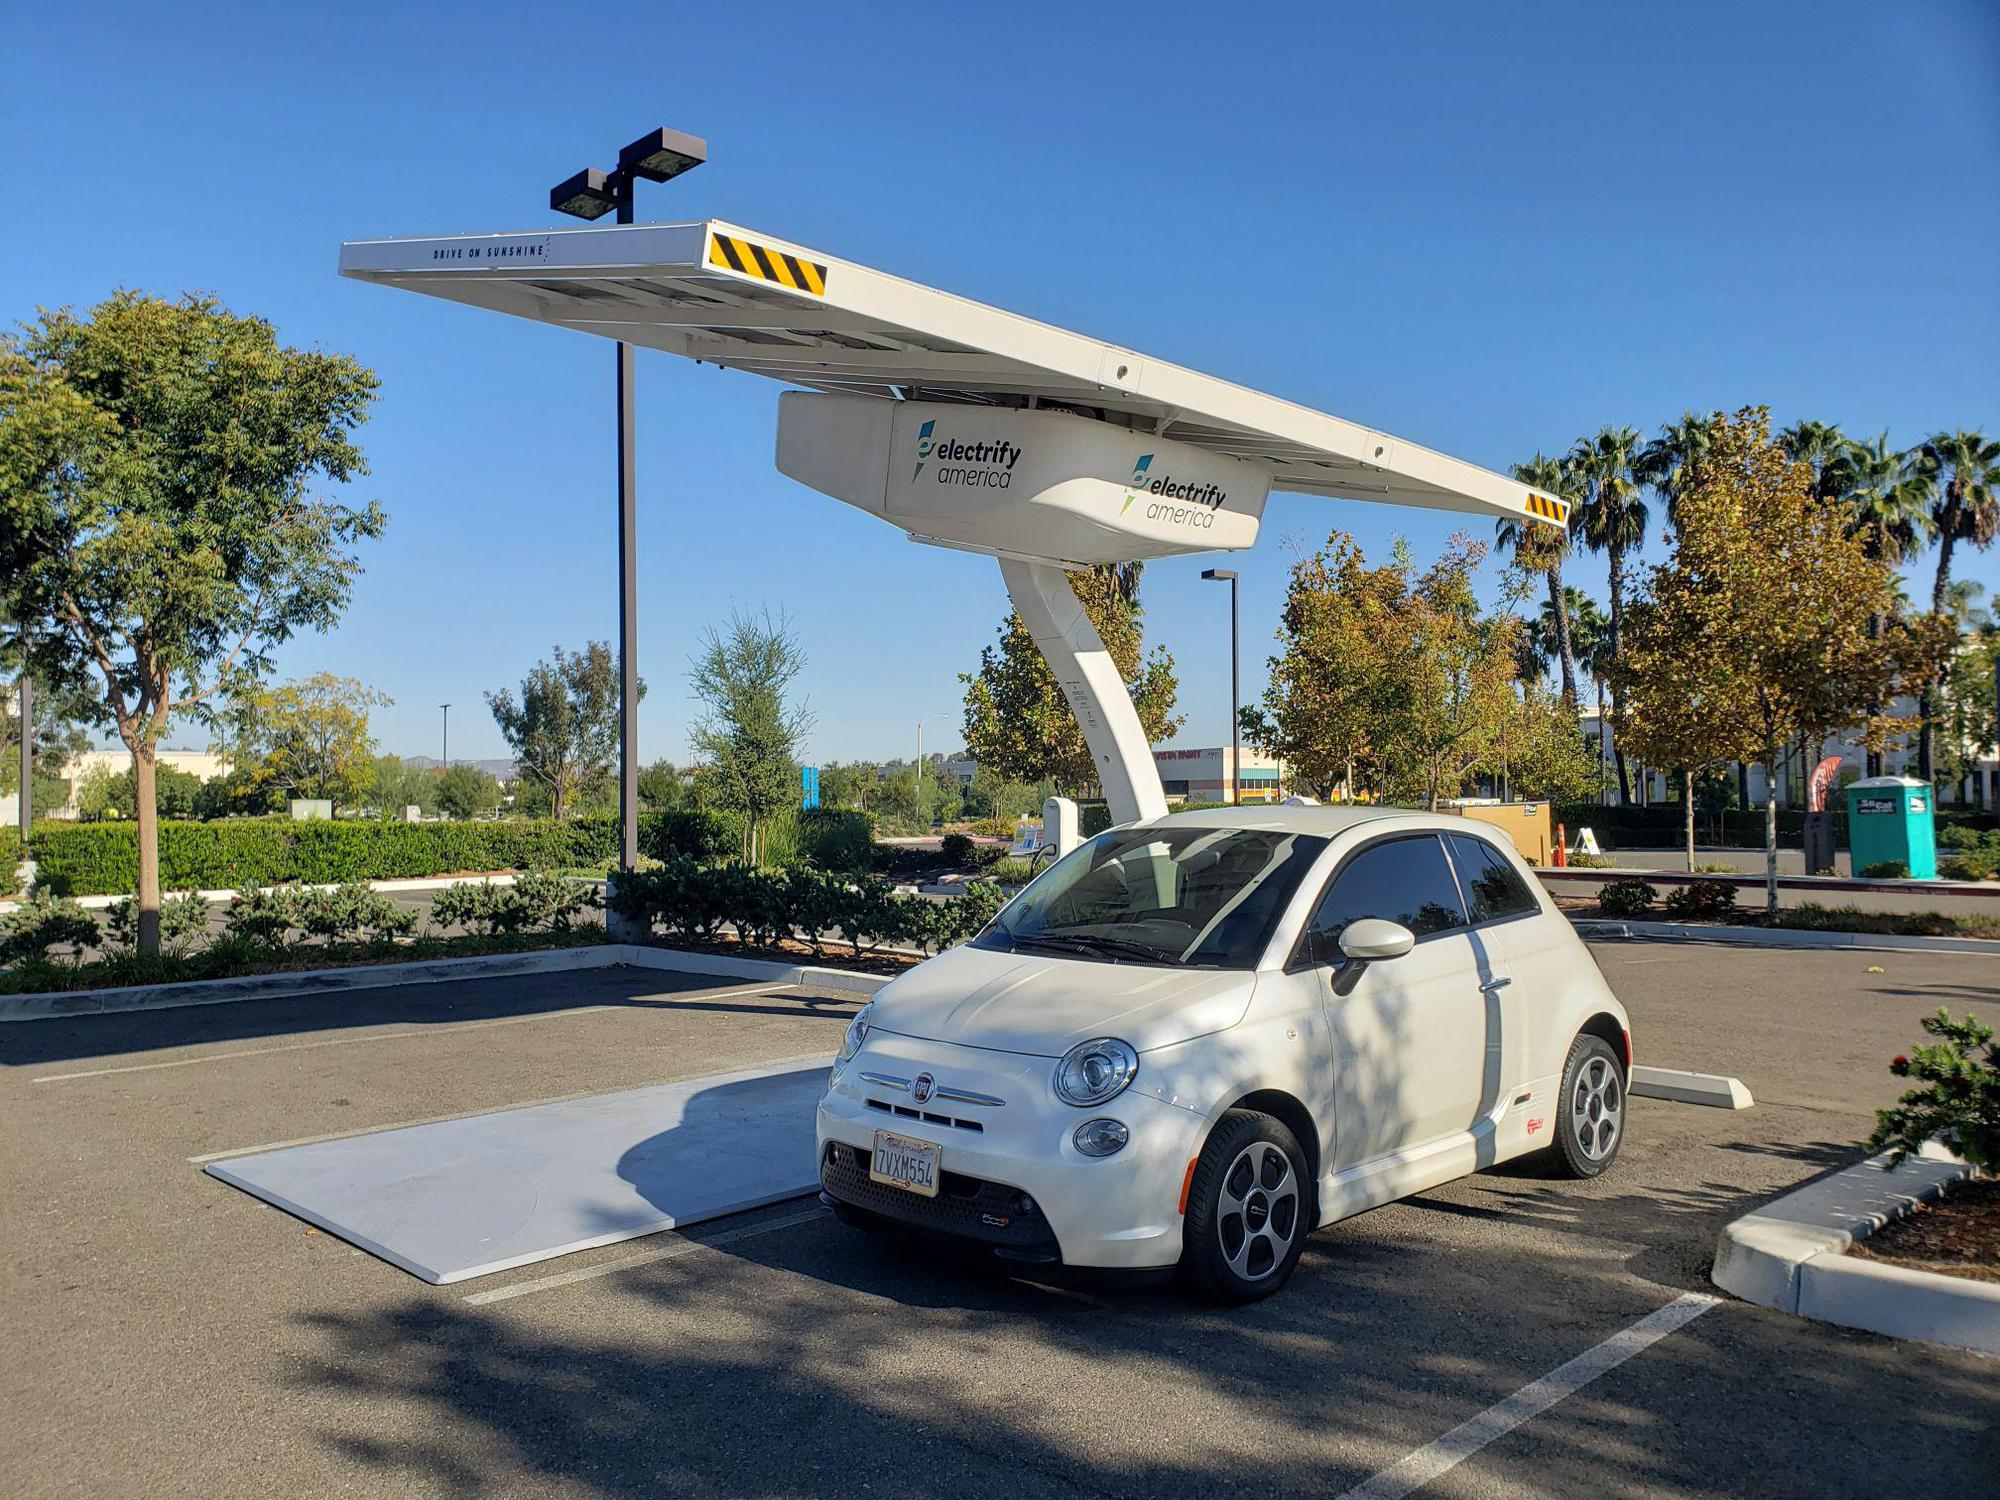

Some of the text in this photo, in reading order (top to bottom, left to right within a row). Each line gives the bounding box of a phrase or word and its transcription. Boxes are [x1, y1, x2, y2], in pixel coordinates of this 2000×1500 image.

[433, 245, 544, 260] DRIVE ON SUNSHINE
[938, 438, 1021, 470] electrify
[938, 466, 1012, 489] america
[1150, 475, 1226, 512] electrify
[1146, 502, 1216, 529] america
[879, 1149, 933, 1186] 7VXM554
